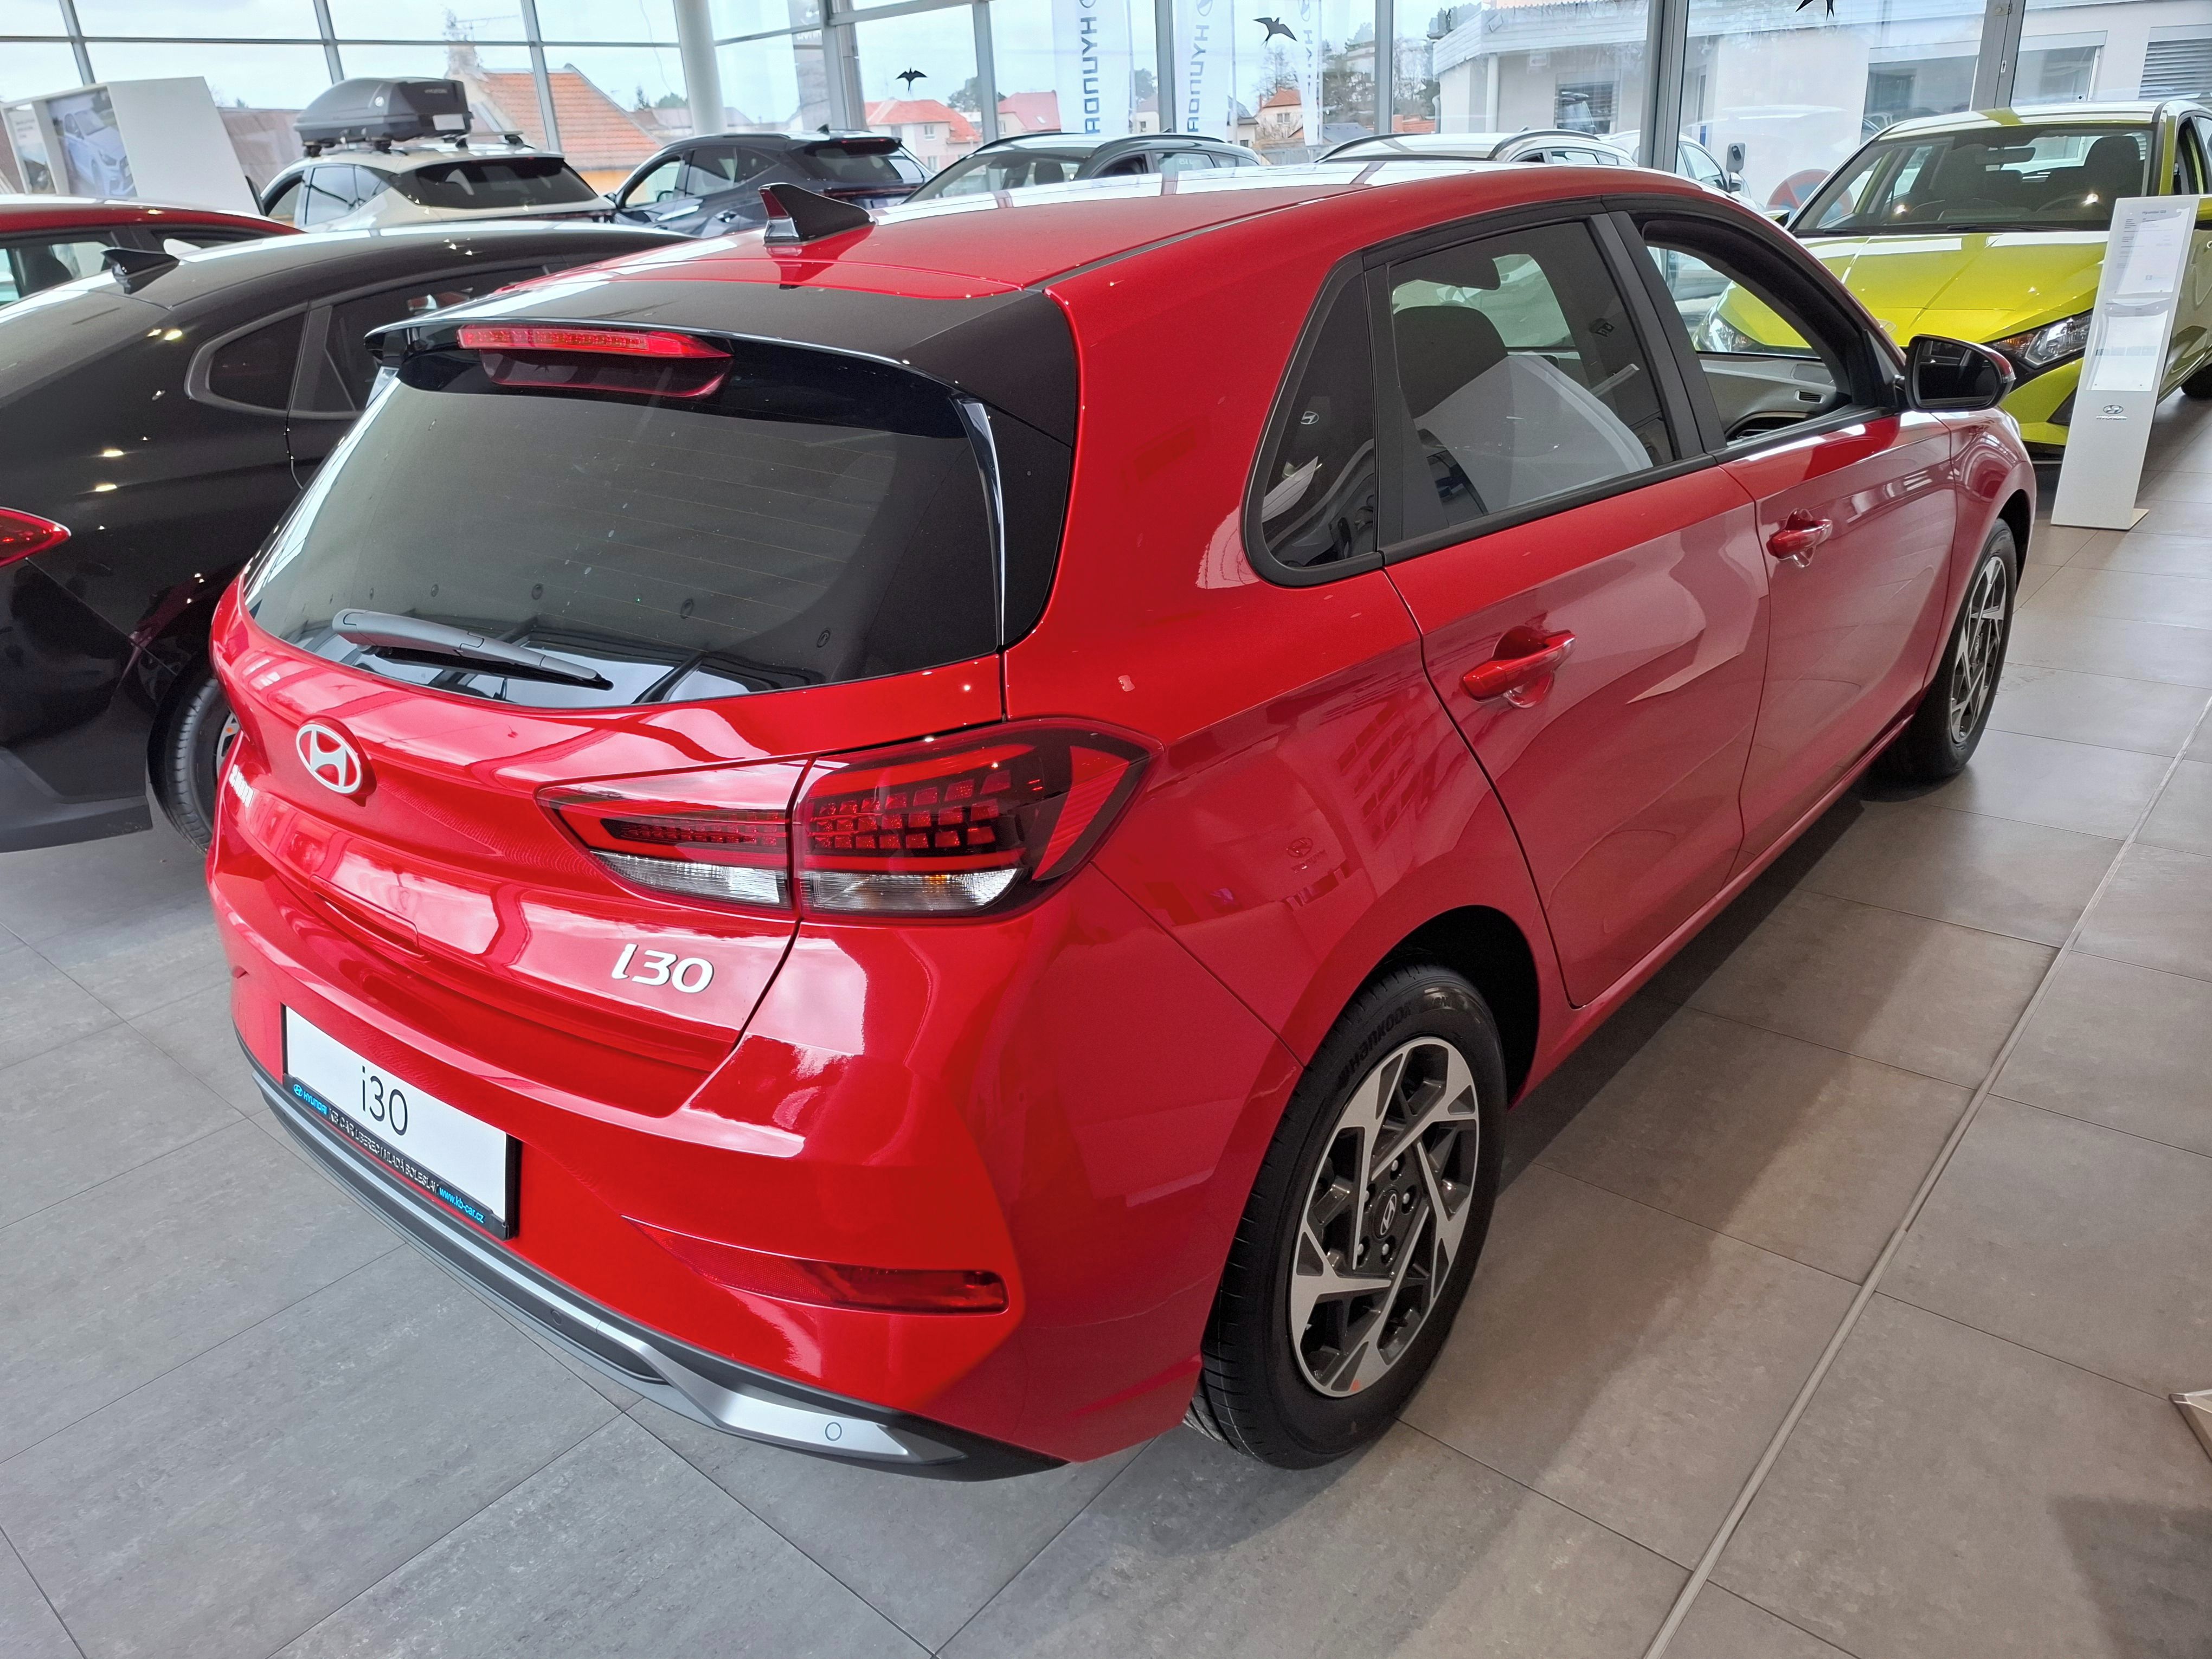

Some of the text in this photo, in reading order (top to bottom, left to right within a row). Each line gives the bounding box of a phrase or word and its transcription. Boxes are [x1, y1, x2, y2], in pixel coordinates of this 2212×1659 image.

[611, 943, 714, 994] i30
[362, 1065, 408, 1135] i30
[303, 1091, 327, 1115] HYUNDAI
[339, 1118, 354, 1137] CAR
[405, 1164, 439, 1192] BOLESLAV
[439, 1187, 484, 1224] www.kb-car.cz
